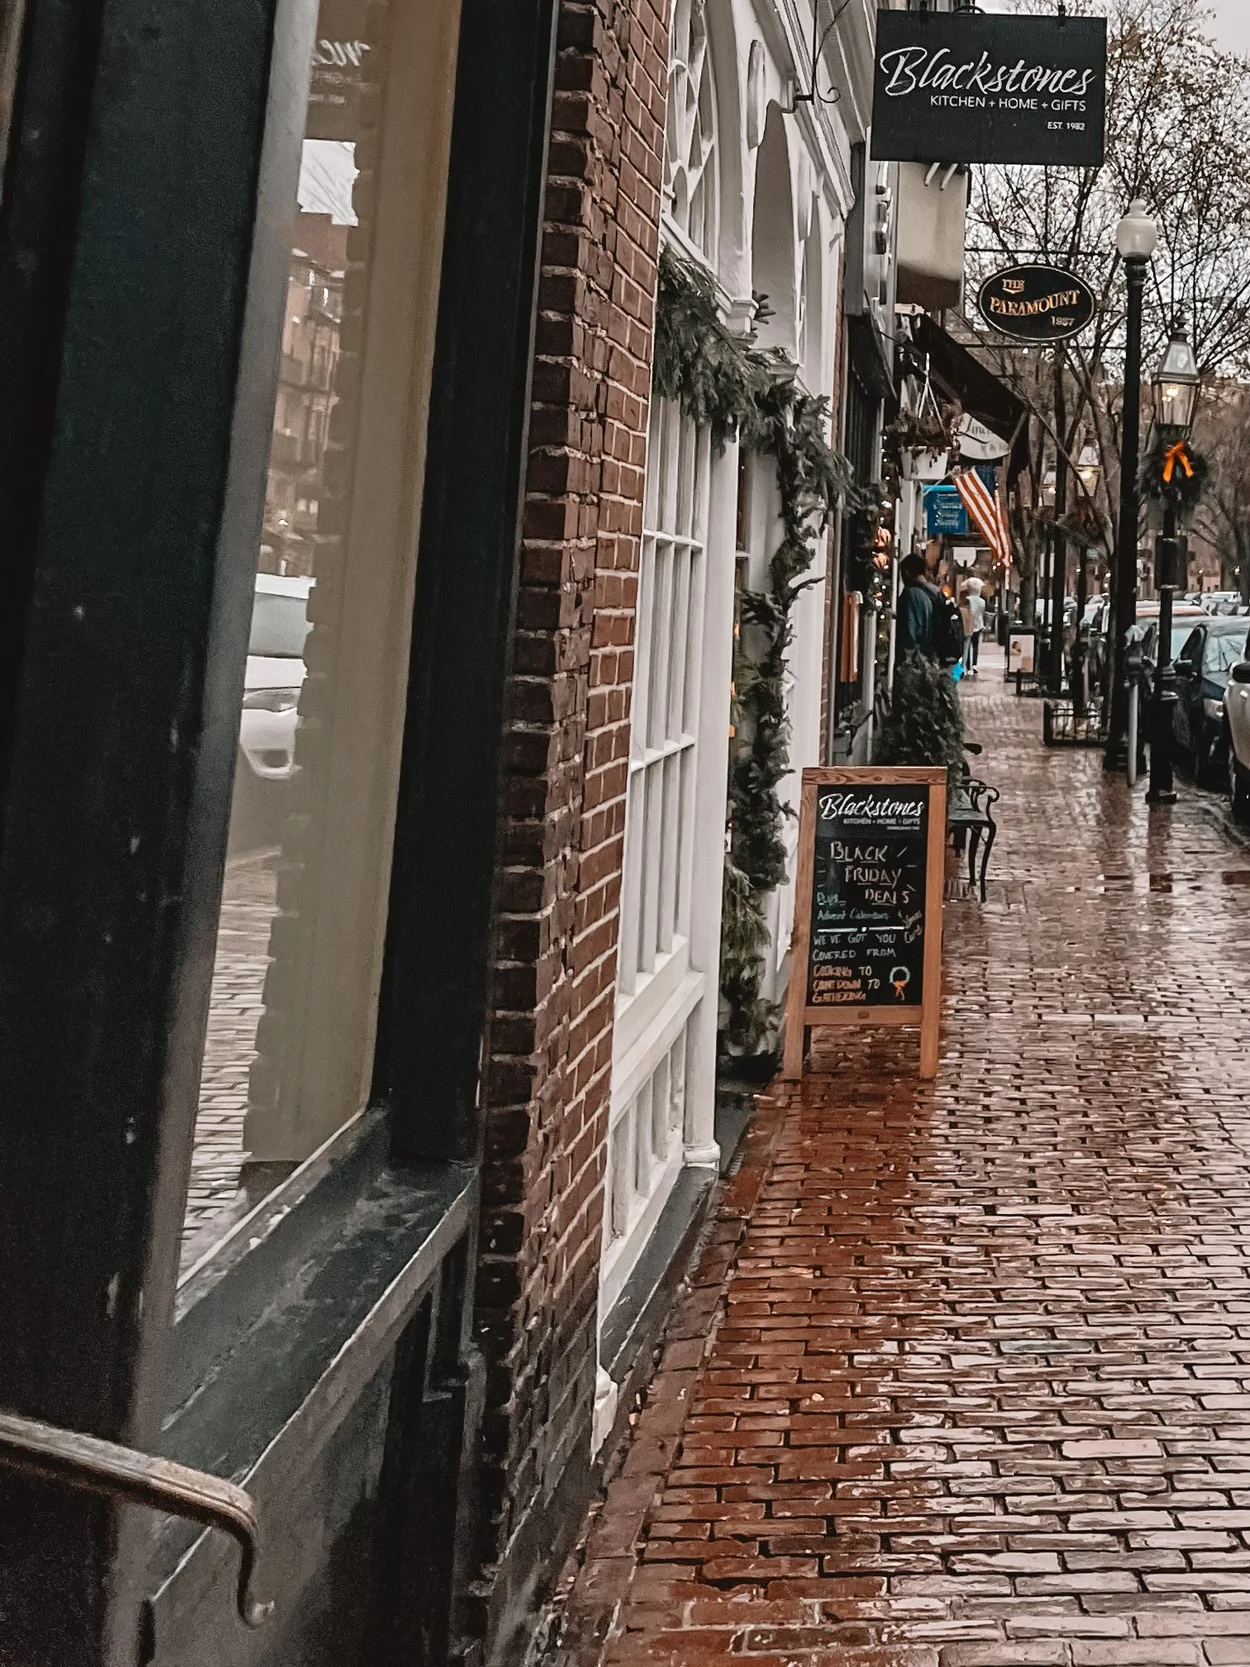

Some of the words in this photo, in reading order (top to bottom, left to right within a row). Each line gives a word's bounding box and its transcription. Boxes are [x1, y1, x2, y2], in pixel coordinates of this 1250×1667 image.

[880, 46, 1097, 96] Blackstones
[930, 95, 986, 108] KITCHEN
[998, 98, 1038, 109] HOME
[1051, 99, 1086, 112] GIFTS
[1002, 279, 1025, 289] THE
[989, 290, 1080, 315] PARAMOUNT
[819, 793, 924, 820] Blackstones
[830, 841, 888, 862] BLACK
[844, 865, 902, 889] FRIDAY
[848, 933, 867, 944] GOT
[875, 933, 896, 944] YOU
[812, 949, 857, 962] COVERED
[866, 947, 897, 958] FROM
[858, 965, 873, 976] TO
[867, 978, 881, 990] TO
